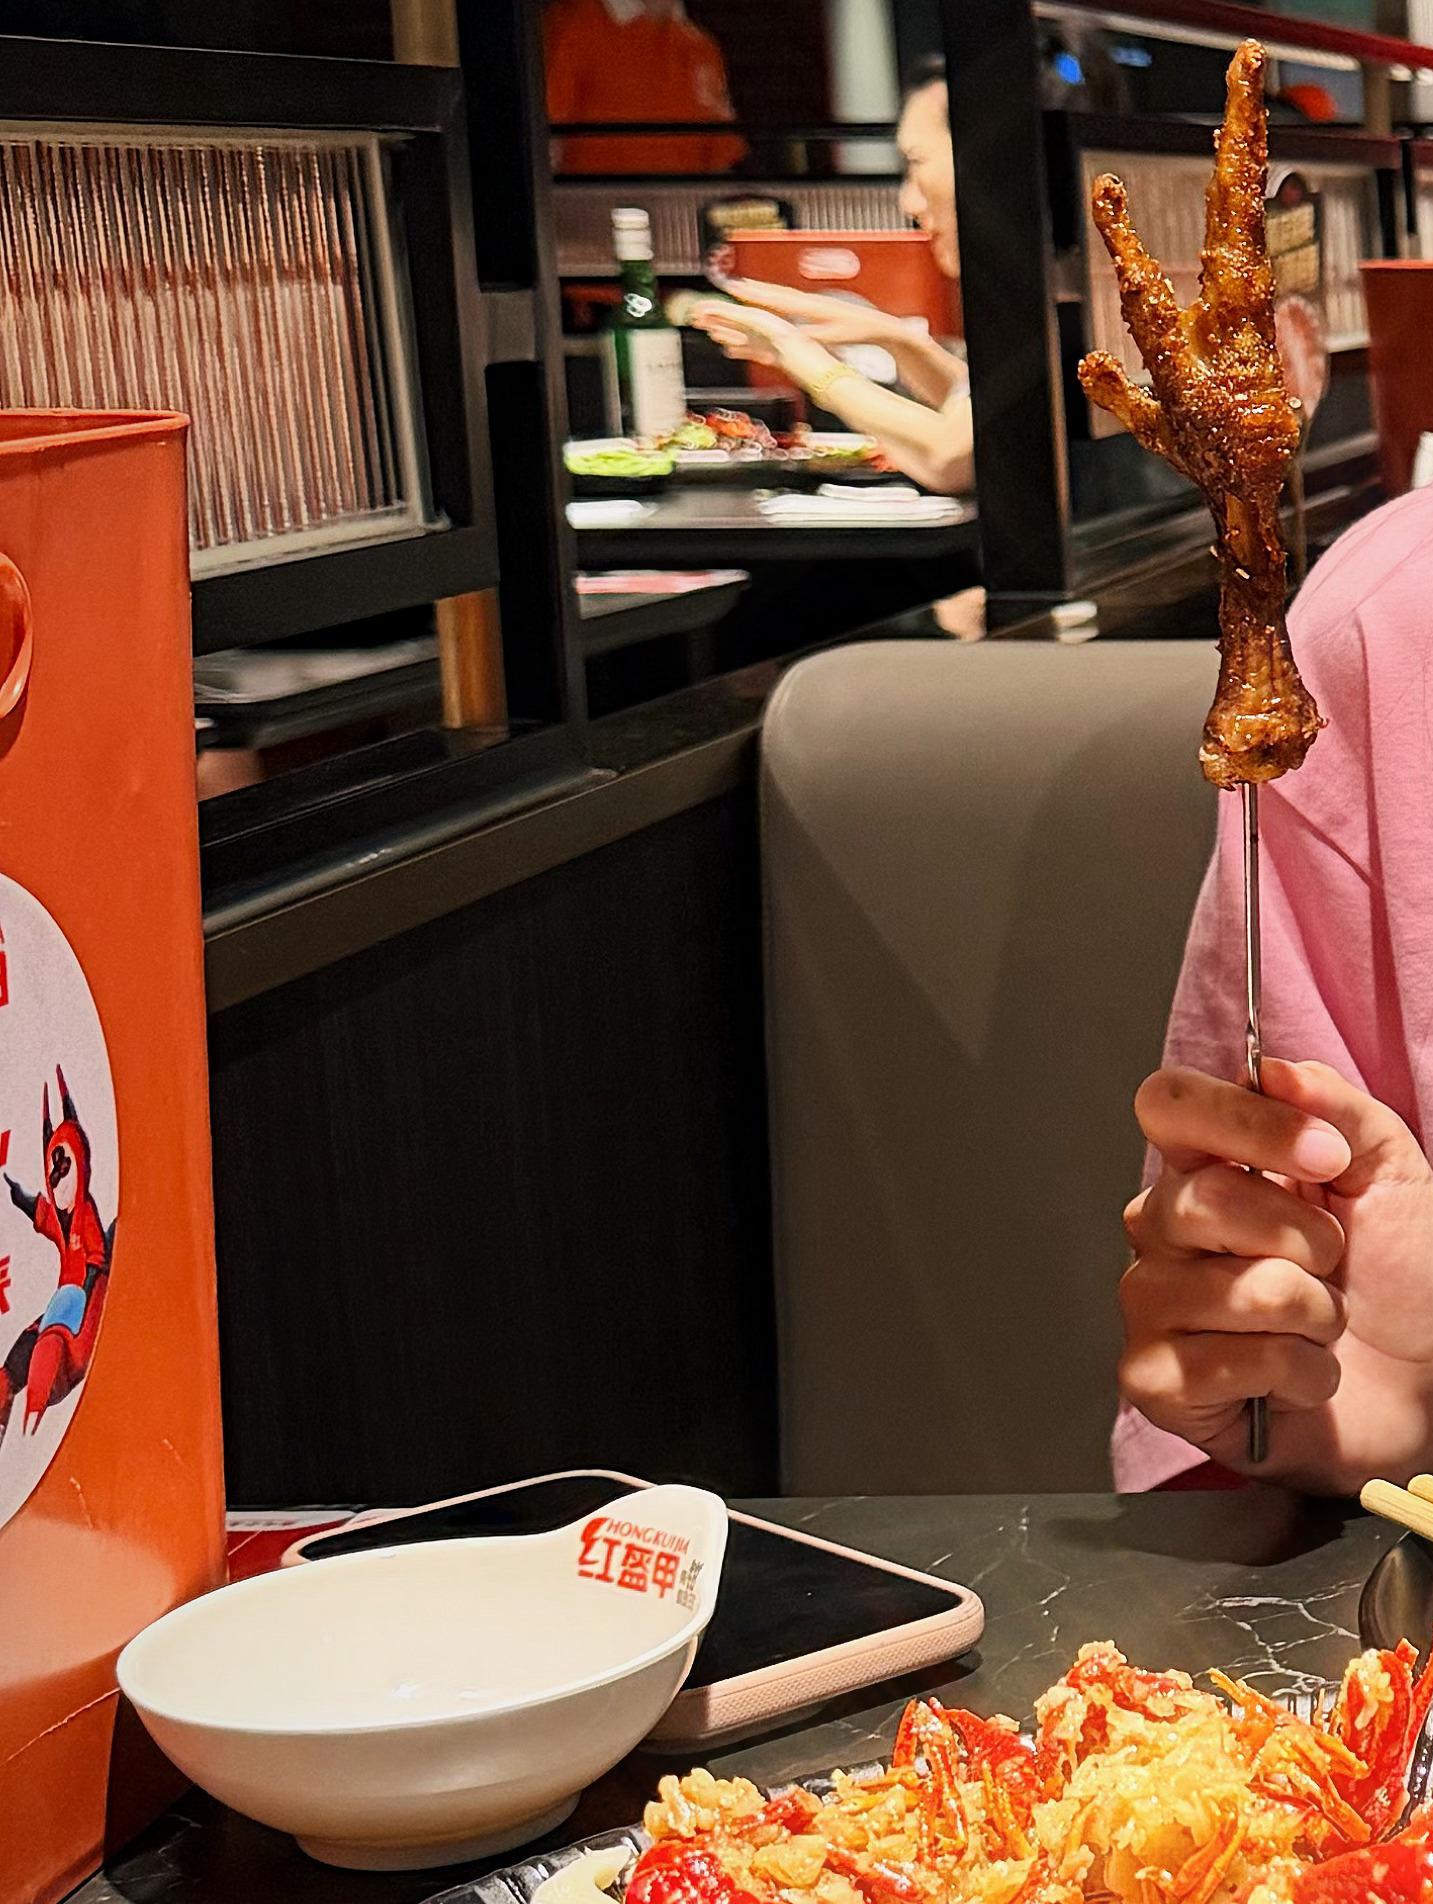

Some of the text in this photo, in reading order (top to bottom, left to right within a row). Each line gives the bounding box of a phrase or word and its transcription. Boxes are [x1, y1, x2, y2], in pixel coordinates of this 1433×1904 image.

[577, 1517, 681, 1599] 红盔甲
[606, 1518, 690, 1555] HONGKUIJIA
